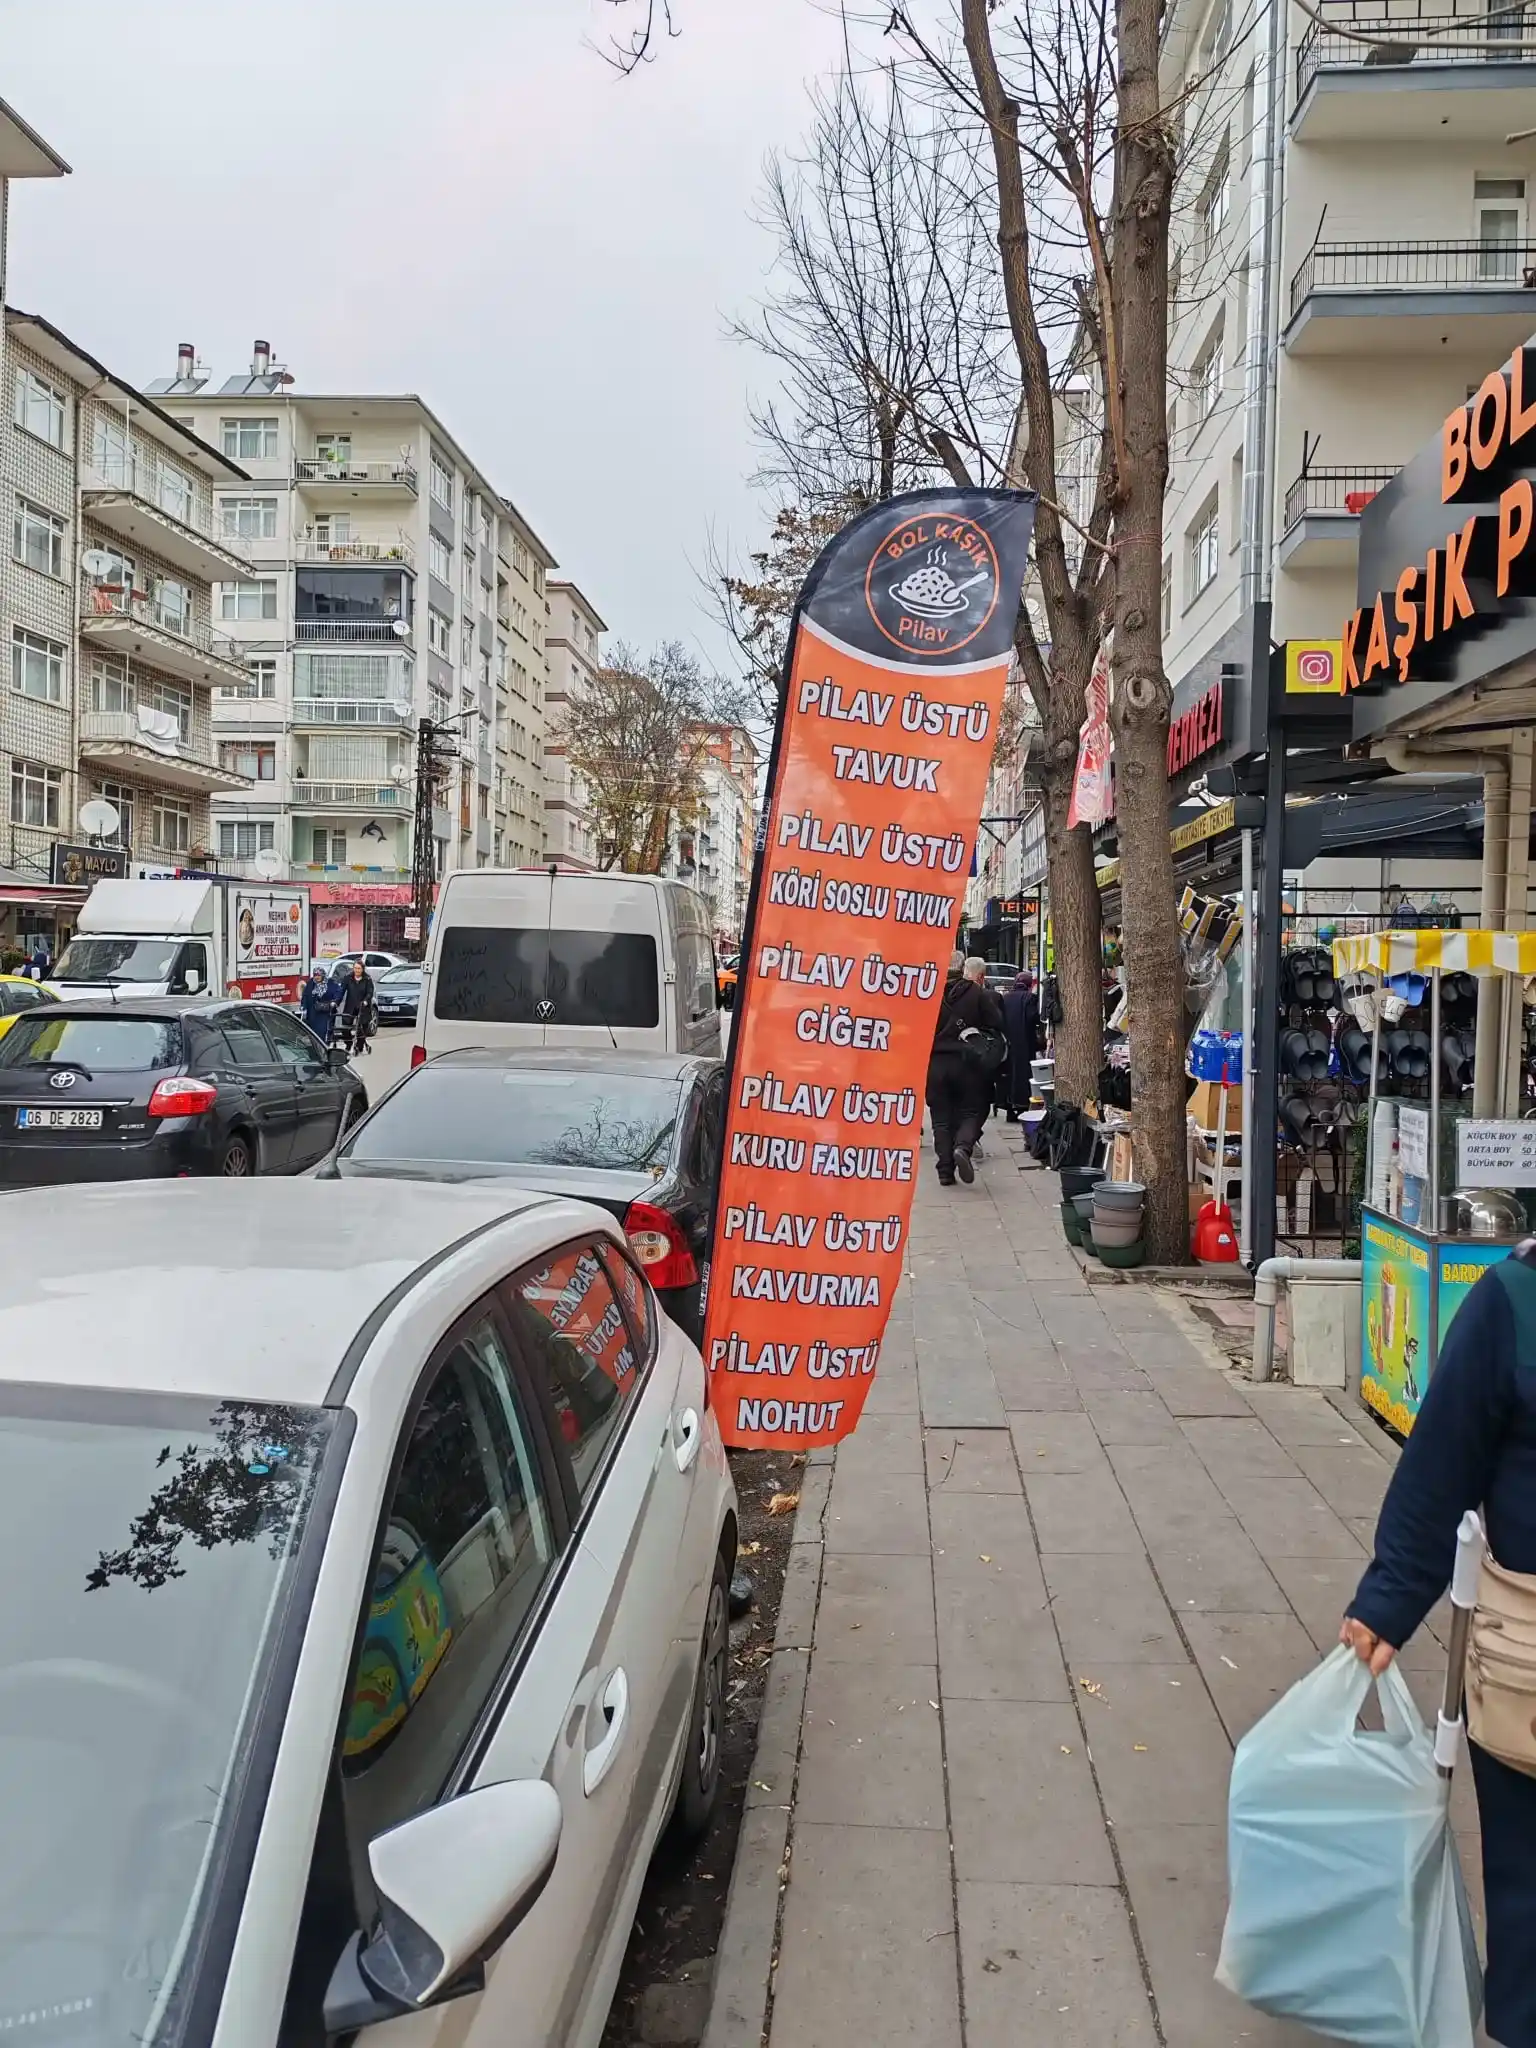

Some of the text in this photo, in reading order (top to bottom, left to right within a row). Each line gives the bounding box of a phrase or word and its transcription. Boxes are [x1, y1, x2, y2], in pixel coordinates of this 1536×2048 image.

[1441, 345, 1536, 504] BOL
[887, 522, 990, 570] BOL KAŞIK
[898, 615, 949, 643] Pilav
[1340, 515, 1476, 698] KAŞIK
[798, 676, 990, 742] PİLAV ÜSTÜ
[832, 744, 942, 793] TAVUK
[84, 856, 118, 873] MAYLO
[778, 809, 874, 858] PİLAV
[879, 823, 965, 872] ÜSTÜ
[769, 867, 956, 928] KÖRİ SOSLU TAVUK
[758, 940, 938, 1000] PİLAV ÜSTÜ
[796, 1003, 891, 1050] CİĞER
[27, 1111, 100, 1126] 06 DE 2823
[740, 1071, 916, 1125] PİLAV ÜSTÜ
[730, 1132, 913, 1181] KURU FASULYE
[1466, 1131, 1497, 1141] KÜÇÜK
[1498, 1132, 1517, 1140] BOY
[1467, 1145, 1491, 1154] ORTA
[1493, 1146, 1512, 1154] BOY
[1466, 1158, 1496, 1167] BÜYÜK
[724, 1202, 902, 1253] PİLAV ÜSTÜ
[731, 1265, 881, 1308] KAVURMA
[1442, 1263, 1488, 1283] BARDA
[709, 1331, 880, 1379] PİLAV ÜSTÜ
[736, 1397, 845, 1434] NOHUT
